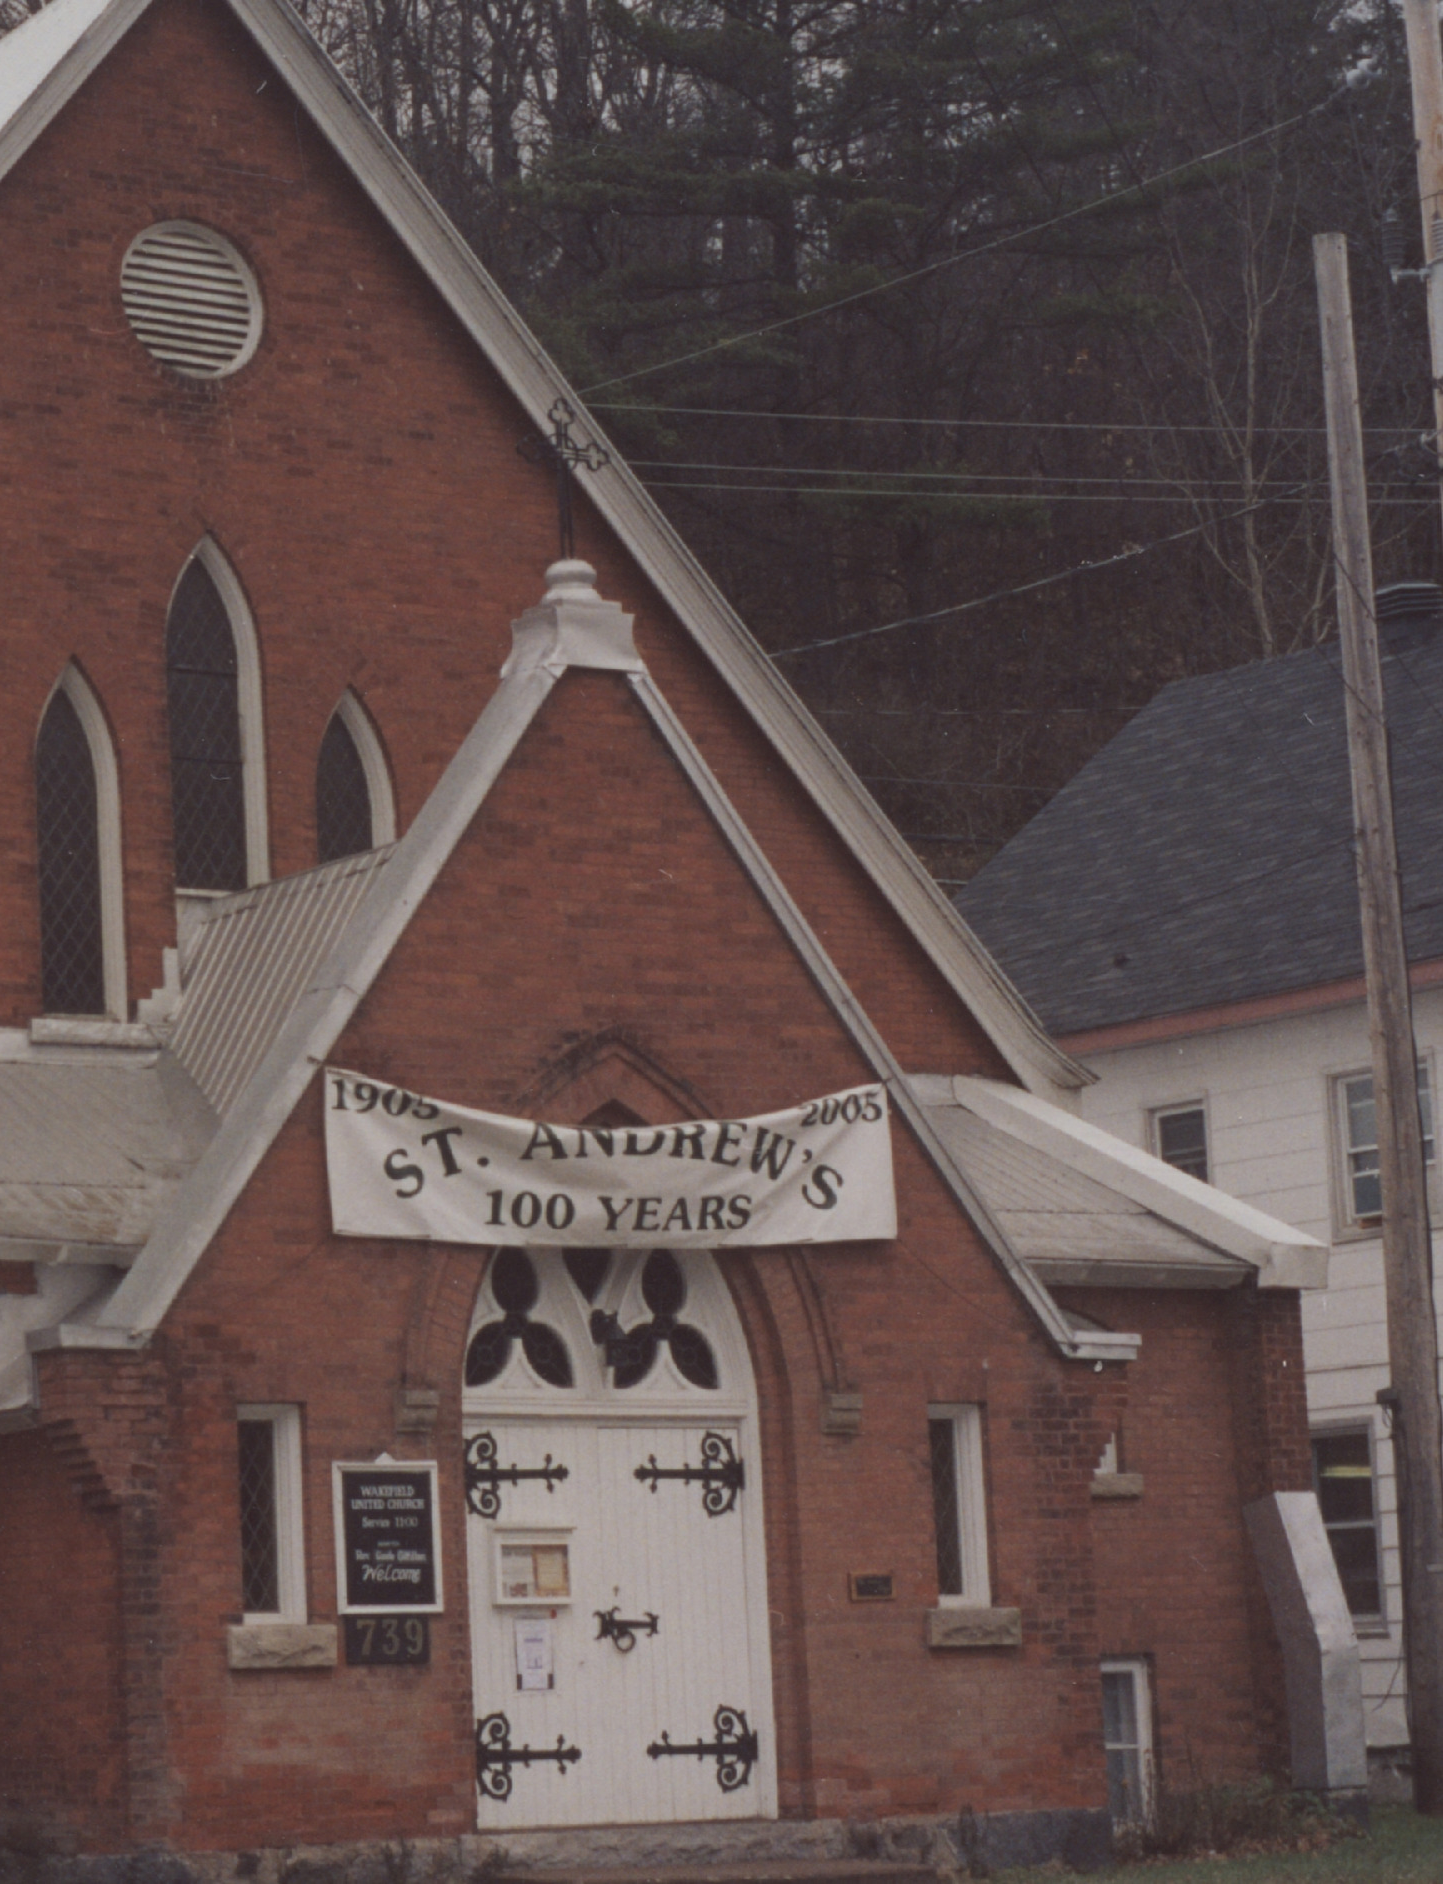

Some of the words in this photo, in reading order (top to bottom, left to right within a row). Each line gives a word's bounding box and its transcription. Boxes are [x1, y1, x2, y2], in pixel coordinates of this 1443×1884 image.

[330, 1077, 442, 1120] 1905
[800, 1091, 883, 1128] 2005
[383, 1126, 490, 1200] ST.
[520, 1120, 844, 1211] ANDREW'S
[484, 1189, 576, 1230] 100
[597, 1193, 753, 1232] YEARS
[351, 1498, 385, 1510] UNITED
[387, 1498, 425, 1510] CHURCH
[360, 1485, 415, 1497] WAKEFIELD
[361, 1563, 422, 1584] Welcome
[356, 1618, 424, 1657] 739
